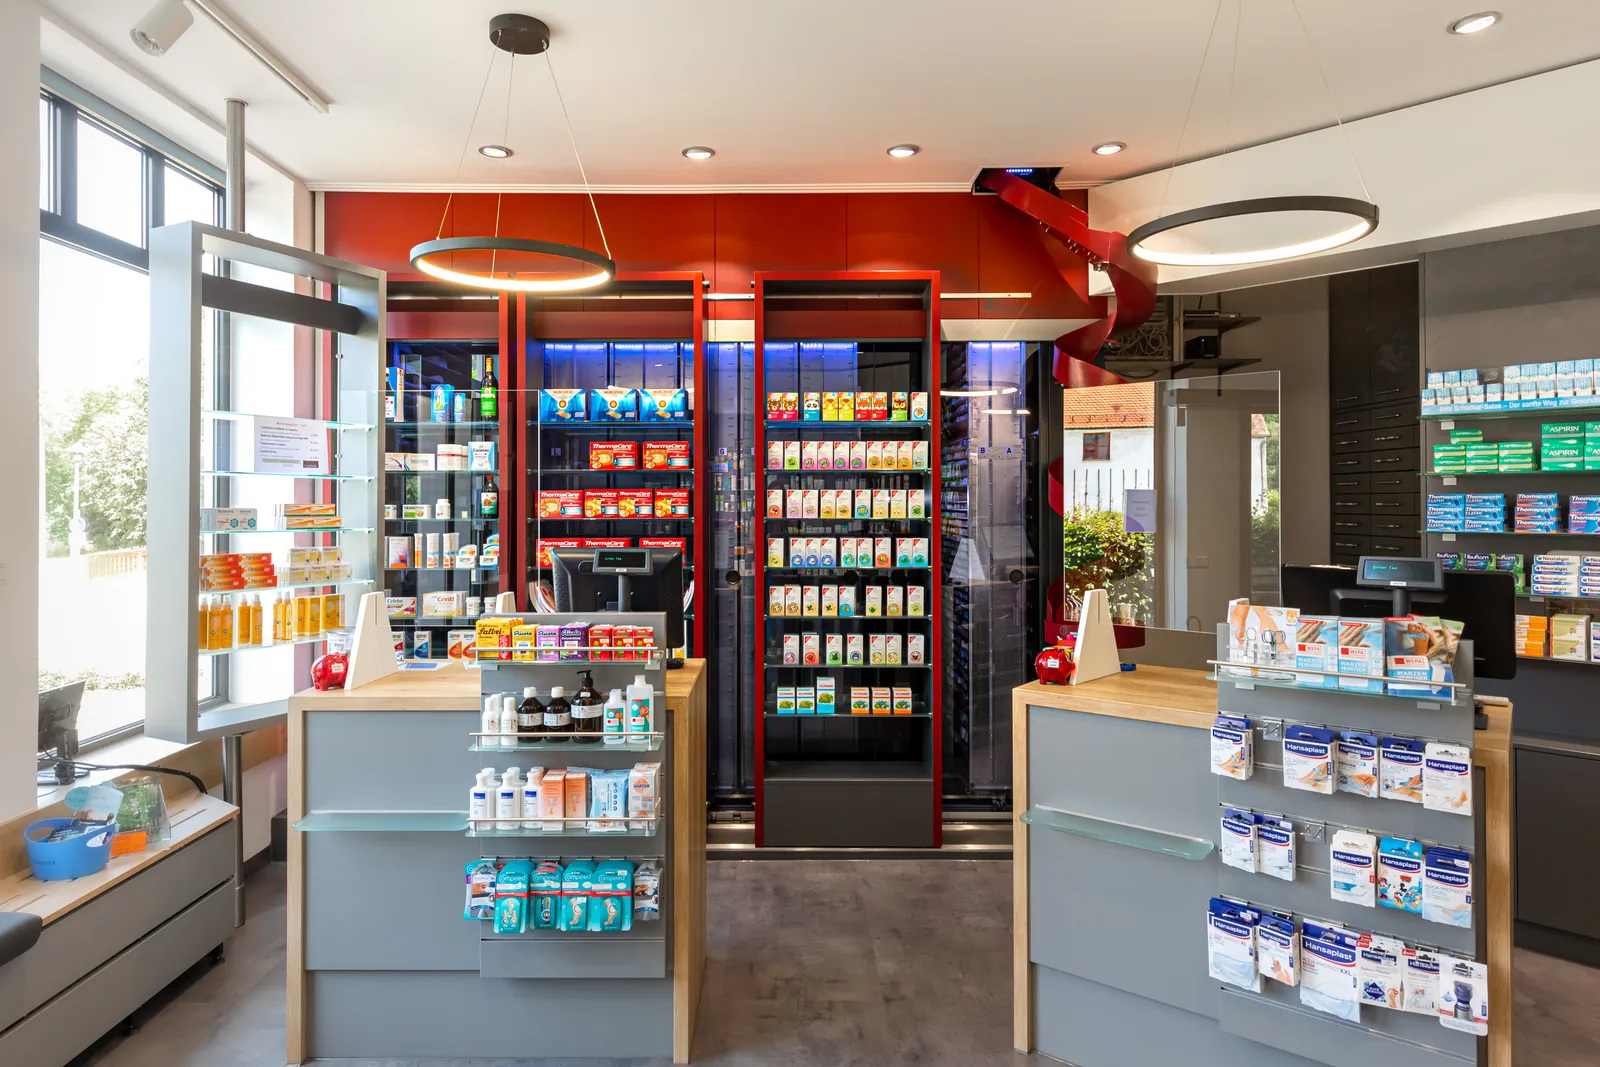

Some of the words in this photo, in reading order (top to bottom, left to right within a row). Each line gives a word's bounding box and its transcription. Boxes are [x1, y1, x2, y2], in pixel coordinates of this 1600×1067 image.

[1214, 731, 1241, 741] Hansaplast
[1286, 743, 1325, 754] Hansaplast
[1340, 746, 1372, 757] Hansaplast
[1384, 752, 1420, 762] Hansaplast
[1428, 760, 1466, 771] Hansaplast
[1224, 821, 1249, 833] Hansaplast
[1259, 831, 1287, 842] ansaplast
[1334, 853, 1369, 864] Hansaplast
[1382, 858, 1418, 870] Hansaplast
[499, 874, 526, 883] Compeed
[532, 874, 559, 882] Compeed
[564, 872, 591, 882] Compeed
[1427, 872, 1466, 884] Hansaplast
[1215, 922, 1248, 935] Hansaplast
[1261, 930, 1289, 946] Hansaplast
[1305, 941, 1353, 961] Hansaplast
[1340, 968, 1352, 976] XXL
